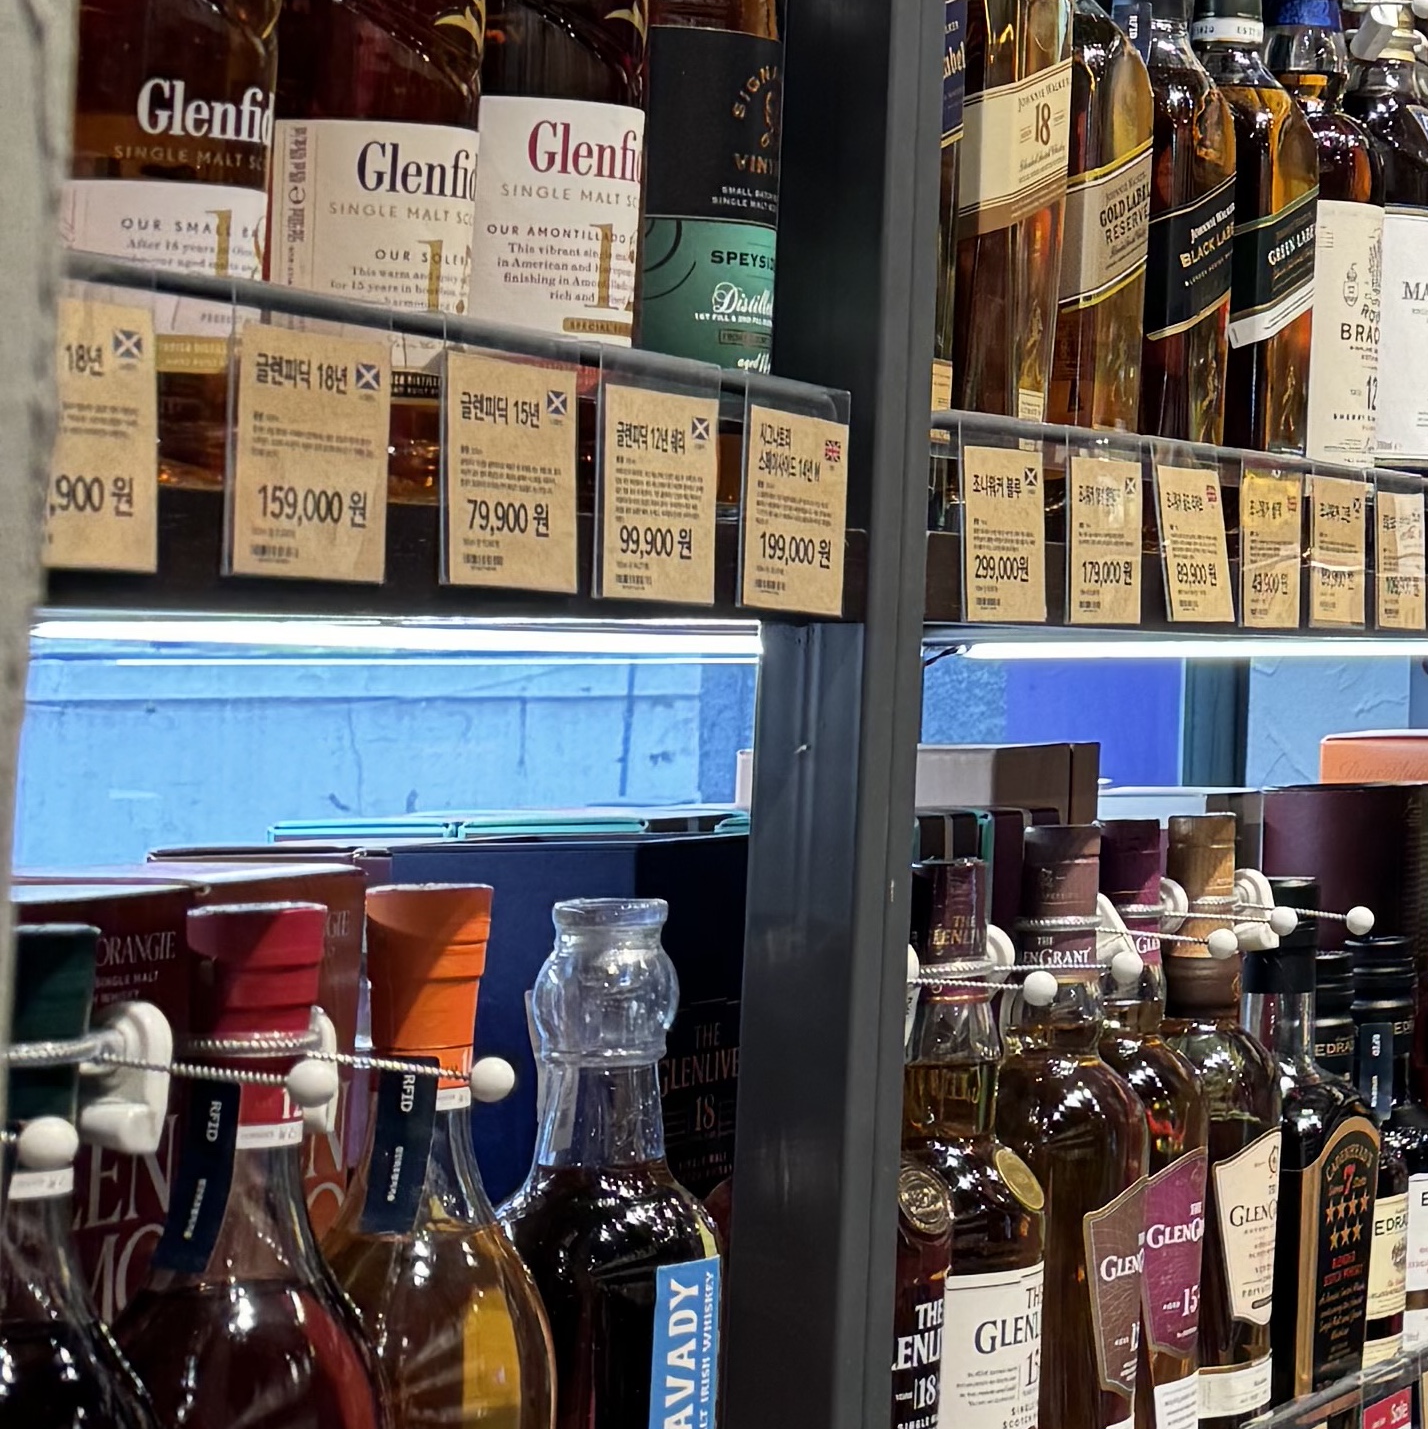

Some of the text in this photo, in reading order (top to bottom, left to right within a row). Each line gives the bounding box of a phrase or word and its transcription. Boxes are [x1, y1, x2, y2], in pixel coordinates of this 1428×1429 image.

[1033, 101, 1052, 147] 18
[500, 182, 621, 207] SINGLE MALT
[256, 483, 368, 529] 159,000 원
[466, 497, 550, 539] 79,900 원
[619, 527, 694, 561] 99,900 원
[758, 531, 832, 571] 199,000 원
[974, 554, 1030, 583] 299,000원
[400, 1072, 417, 1114] RFID
[205, 1099, 222, 1143] RFID
[703, 1270, 715, 1353] WHISKEY
[1182, 1285, 1200, 1319] 15
[917, 1375, 937, 1410] 18
